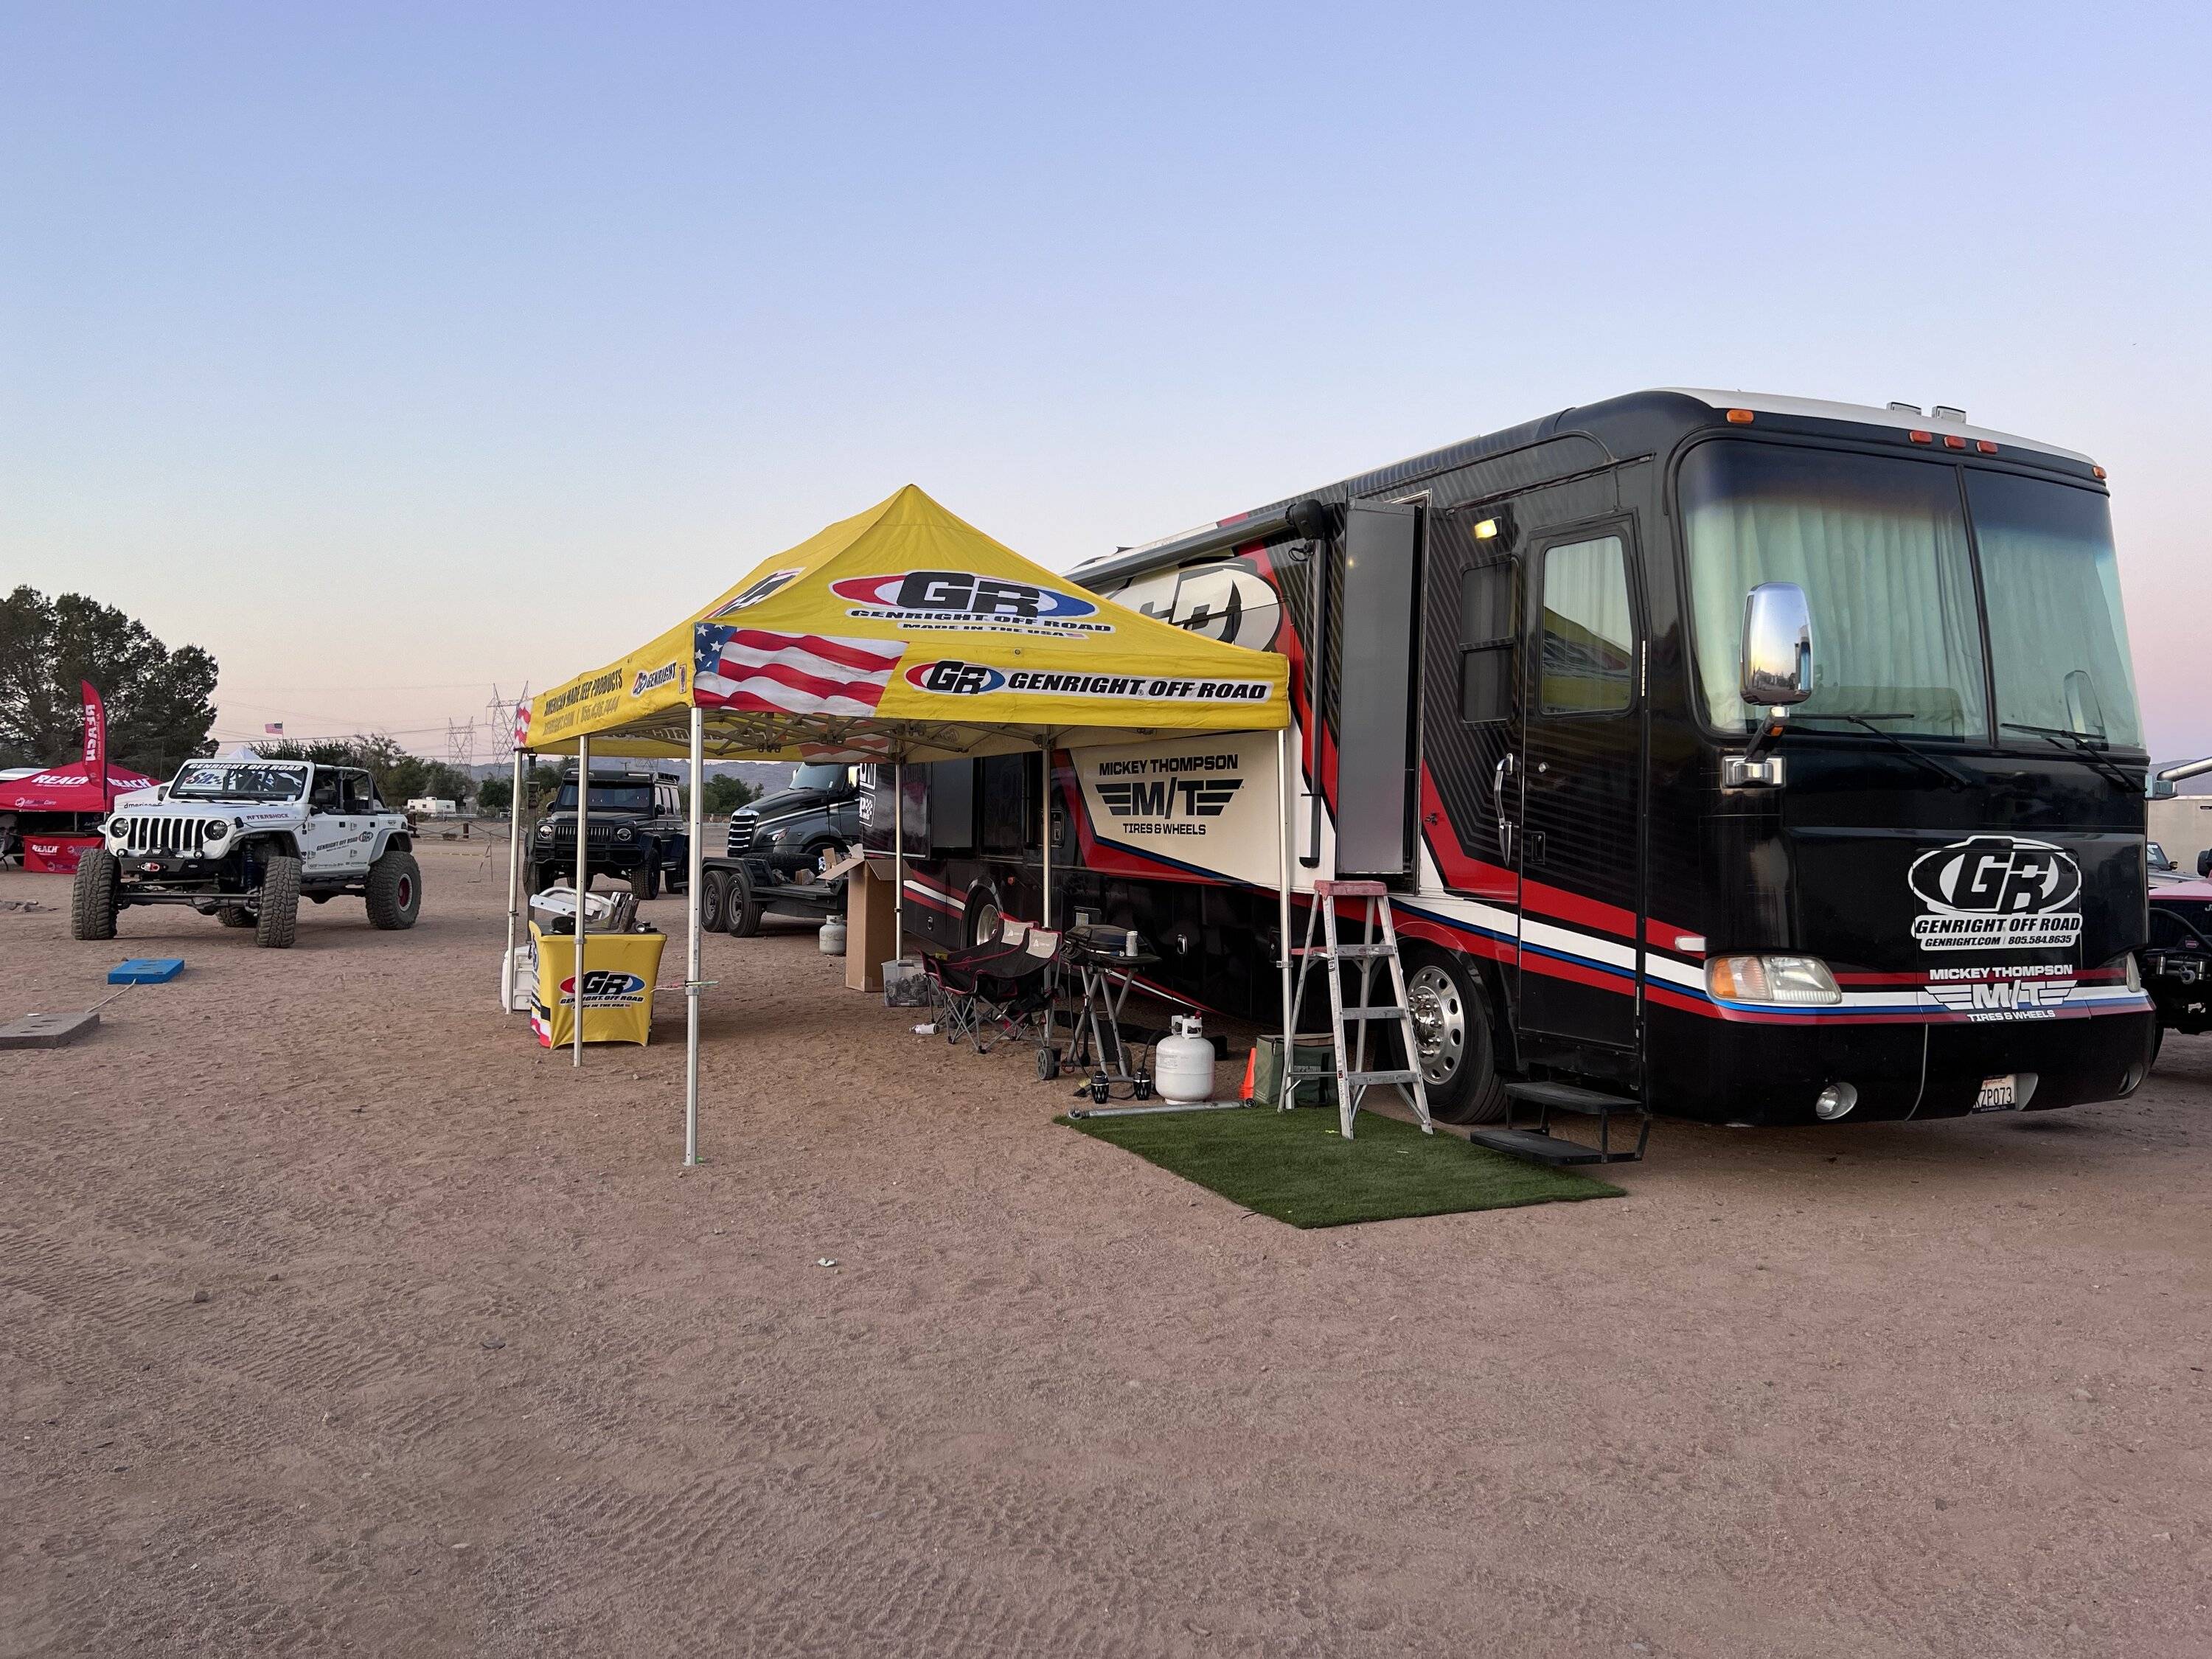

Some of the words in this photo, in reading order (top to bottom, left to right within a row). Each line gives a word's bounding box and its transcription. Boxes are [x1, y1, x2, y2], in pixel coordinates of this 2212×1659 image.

[897, 571, 1040, 617] GR
[851, 610, 988, 622] GENRIGHT
[993, 616, 1045, 625] OFF
[1044, 621, 1111, 632] ROAD
[591, 668, 622, 698] PRODUCTS
[646, 662, 677, 688] GENRIGHT
[927, 661, 987, 694] GR
[1008, 672, 1147, 696] GENRIGHT
[1148, 681, 1195, 697] OFF
[1197, 682, 1267, 699] ROAD
[1099, 760, 1148, 776] MICKEY
[1150, 754, 1239, 773] THOMPSON
[1123, 824, 1153, 834] TIRES
[1155, 824, 1162, 834] &
[1163, 824, 1206, 835] WHEELS
[1952, 838, 2051, 915] GR
[1916, 919, 2007, 933] GENRIGHT
[2009, 919, 2037, 932] OFF
[2039, 917, 2080, 931] ROAD
[1925, 936, 2001, 947] GENRIGHT.COM
[2008, 935, 2073, 945] 805.584.8635
[583, 971, 630, 995] GR
[1930, 967, 1990, 980] MICKEY
[1992, 964, 2073, 978] THOMPSON
[1966, 1012, 2003, 1022] TIRES
[2006, 1012, 2014, 1020] &
[2012, 1010, 2056, 1020] WHEELS
